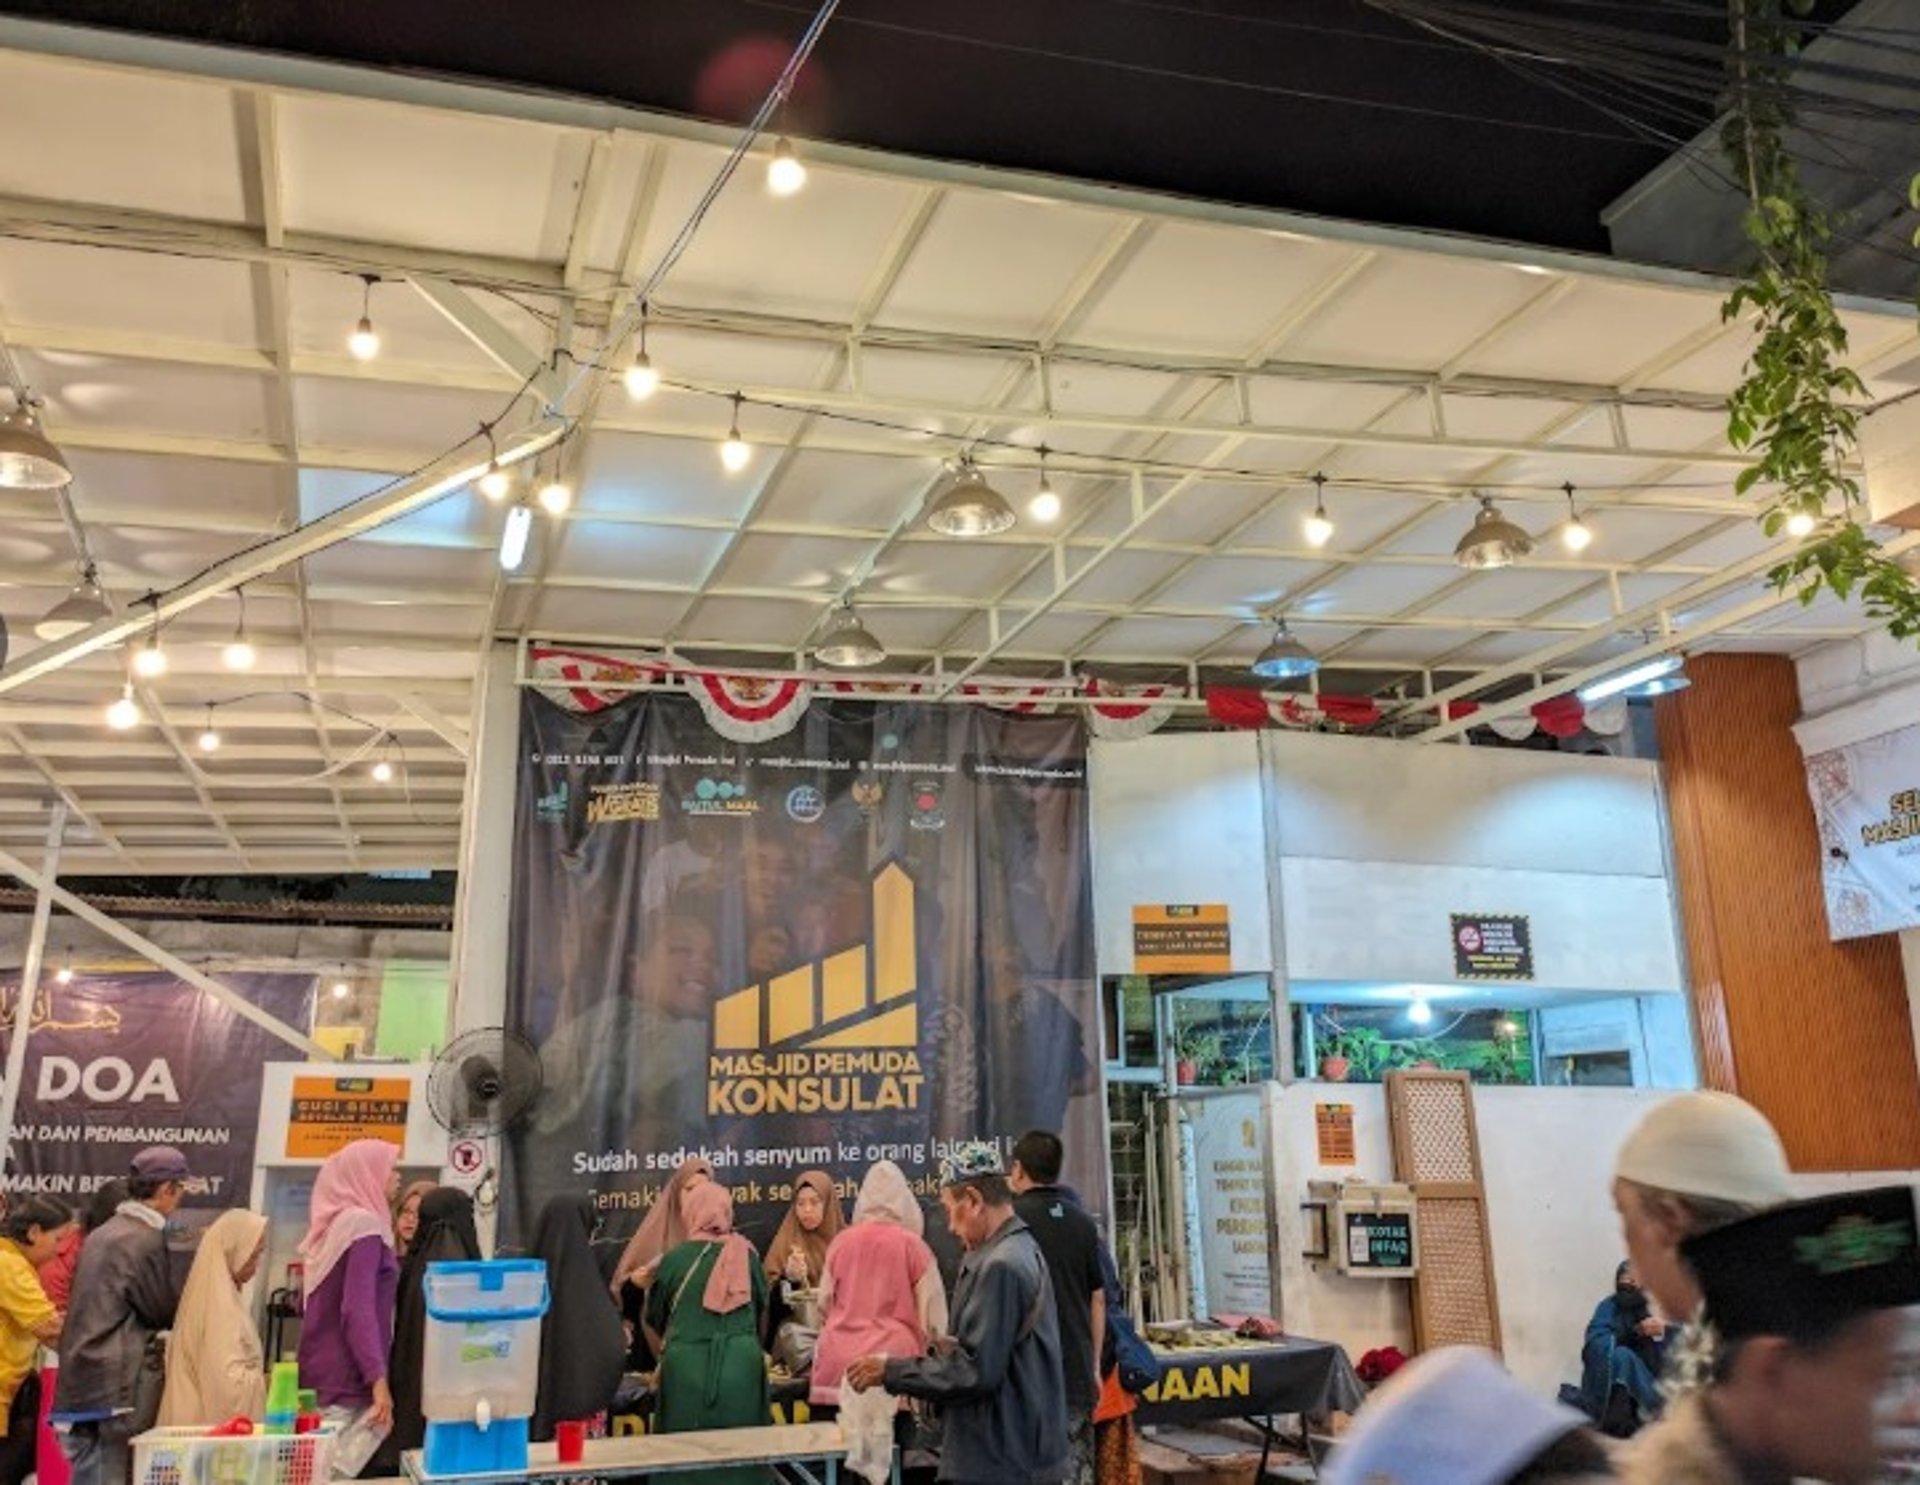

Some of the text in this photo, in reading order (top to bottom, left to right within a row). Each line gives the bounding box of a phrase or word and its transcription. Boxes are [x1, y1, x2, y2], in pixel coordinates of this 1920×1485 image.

[710, 1050, 921, 1077] MASJID PEMUDA
[36, 1055, 180, 1103] DOA
[707, 1074, 925, 1116] KONSULAT
[38, 1124, 80, 1142] DAN
[84, 1126, 230, 1143] PEMBANGUNAN
[573, 1149, 638, 1173] Sudah
[744, 1145, 831, 1169] senyum
[837, 1141, 861, 1162] ke
[866, 1142, 925, 1163] orang
[588, 1184, 662, 1210] emaki
[1370, 1239, 1409, 1254] INFAQ
